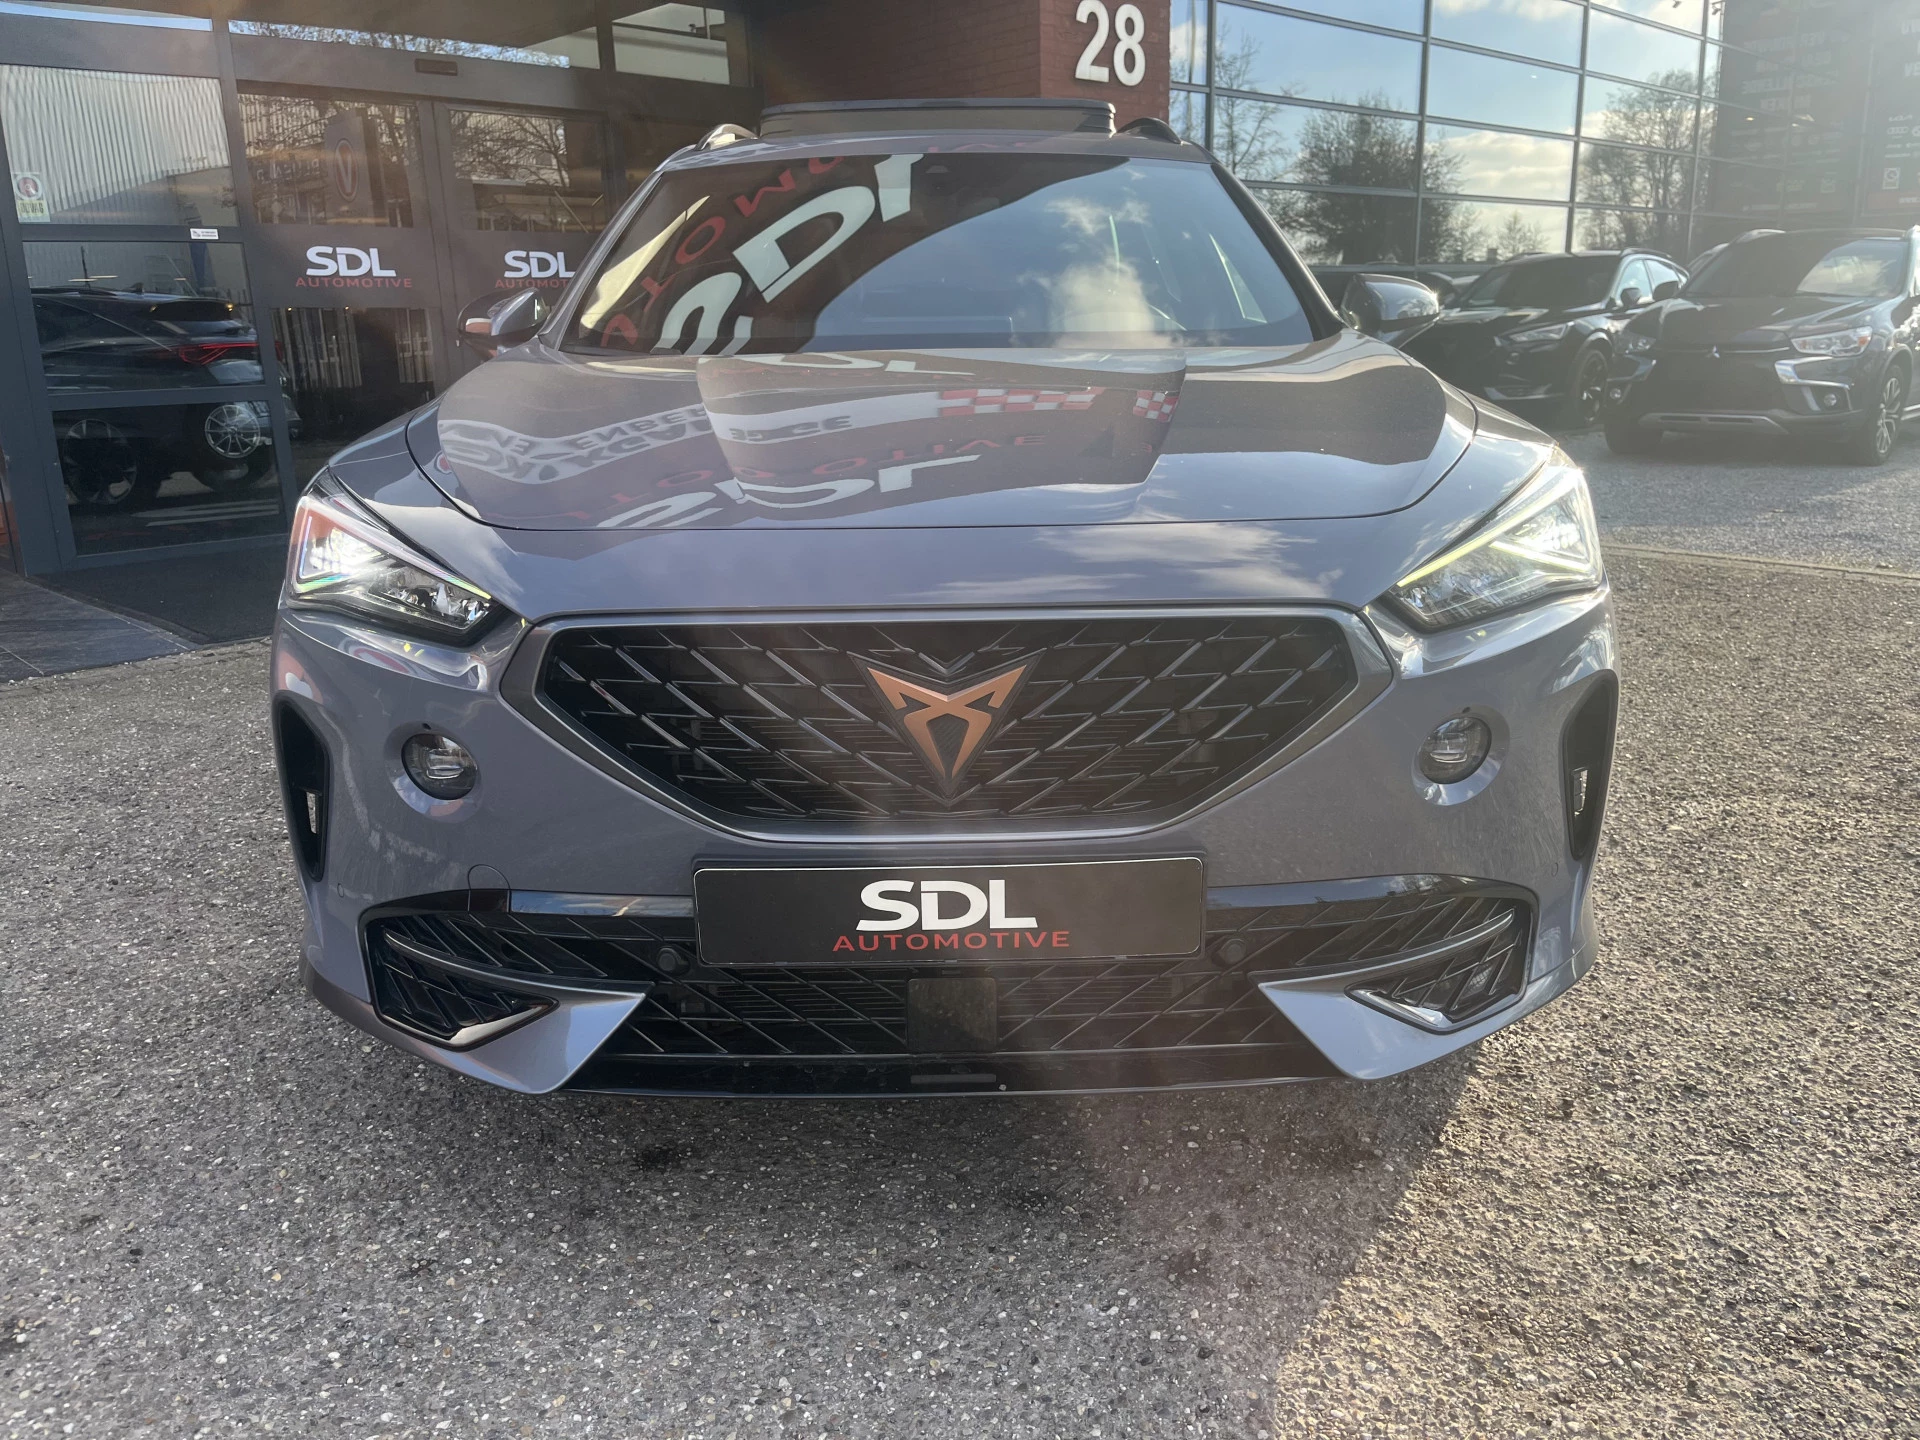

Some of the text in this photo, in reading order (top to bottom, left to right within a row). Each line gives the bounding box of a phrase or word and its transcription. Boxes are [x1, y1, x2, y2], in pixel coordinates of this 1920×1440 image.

[1075, 0, 1146, 86] 28
[306, 245, 397, 277] SDL
[503, 250, 576, 278] SDL
[295, 277, 413, 288] AUTOMOTIVE
[494, 279, 569, 289] AUTOMOT
[855, 879, 1039, 932] SDL
[832, 931, 1070, 952] AUTOMOTIVE
